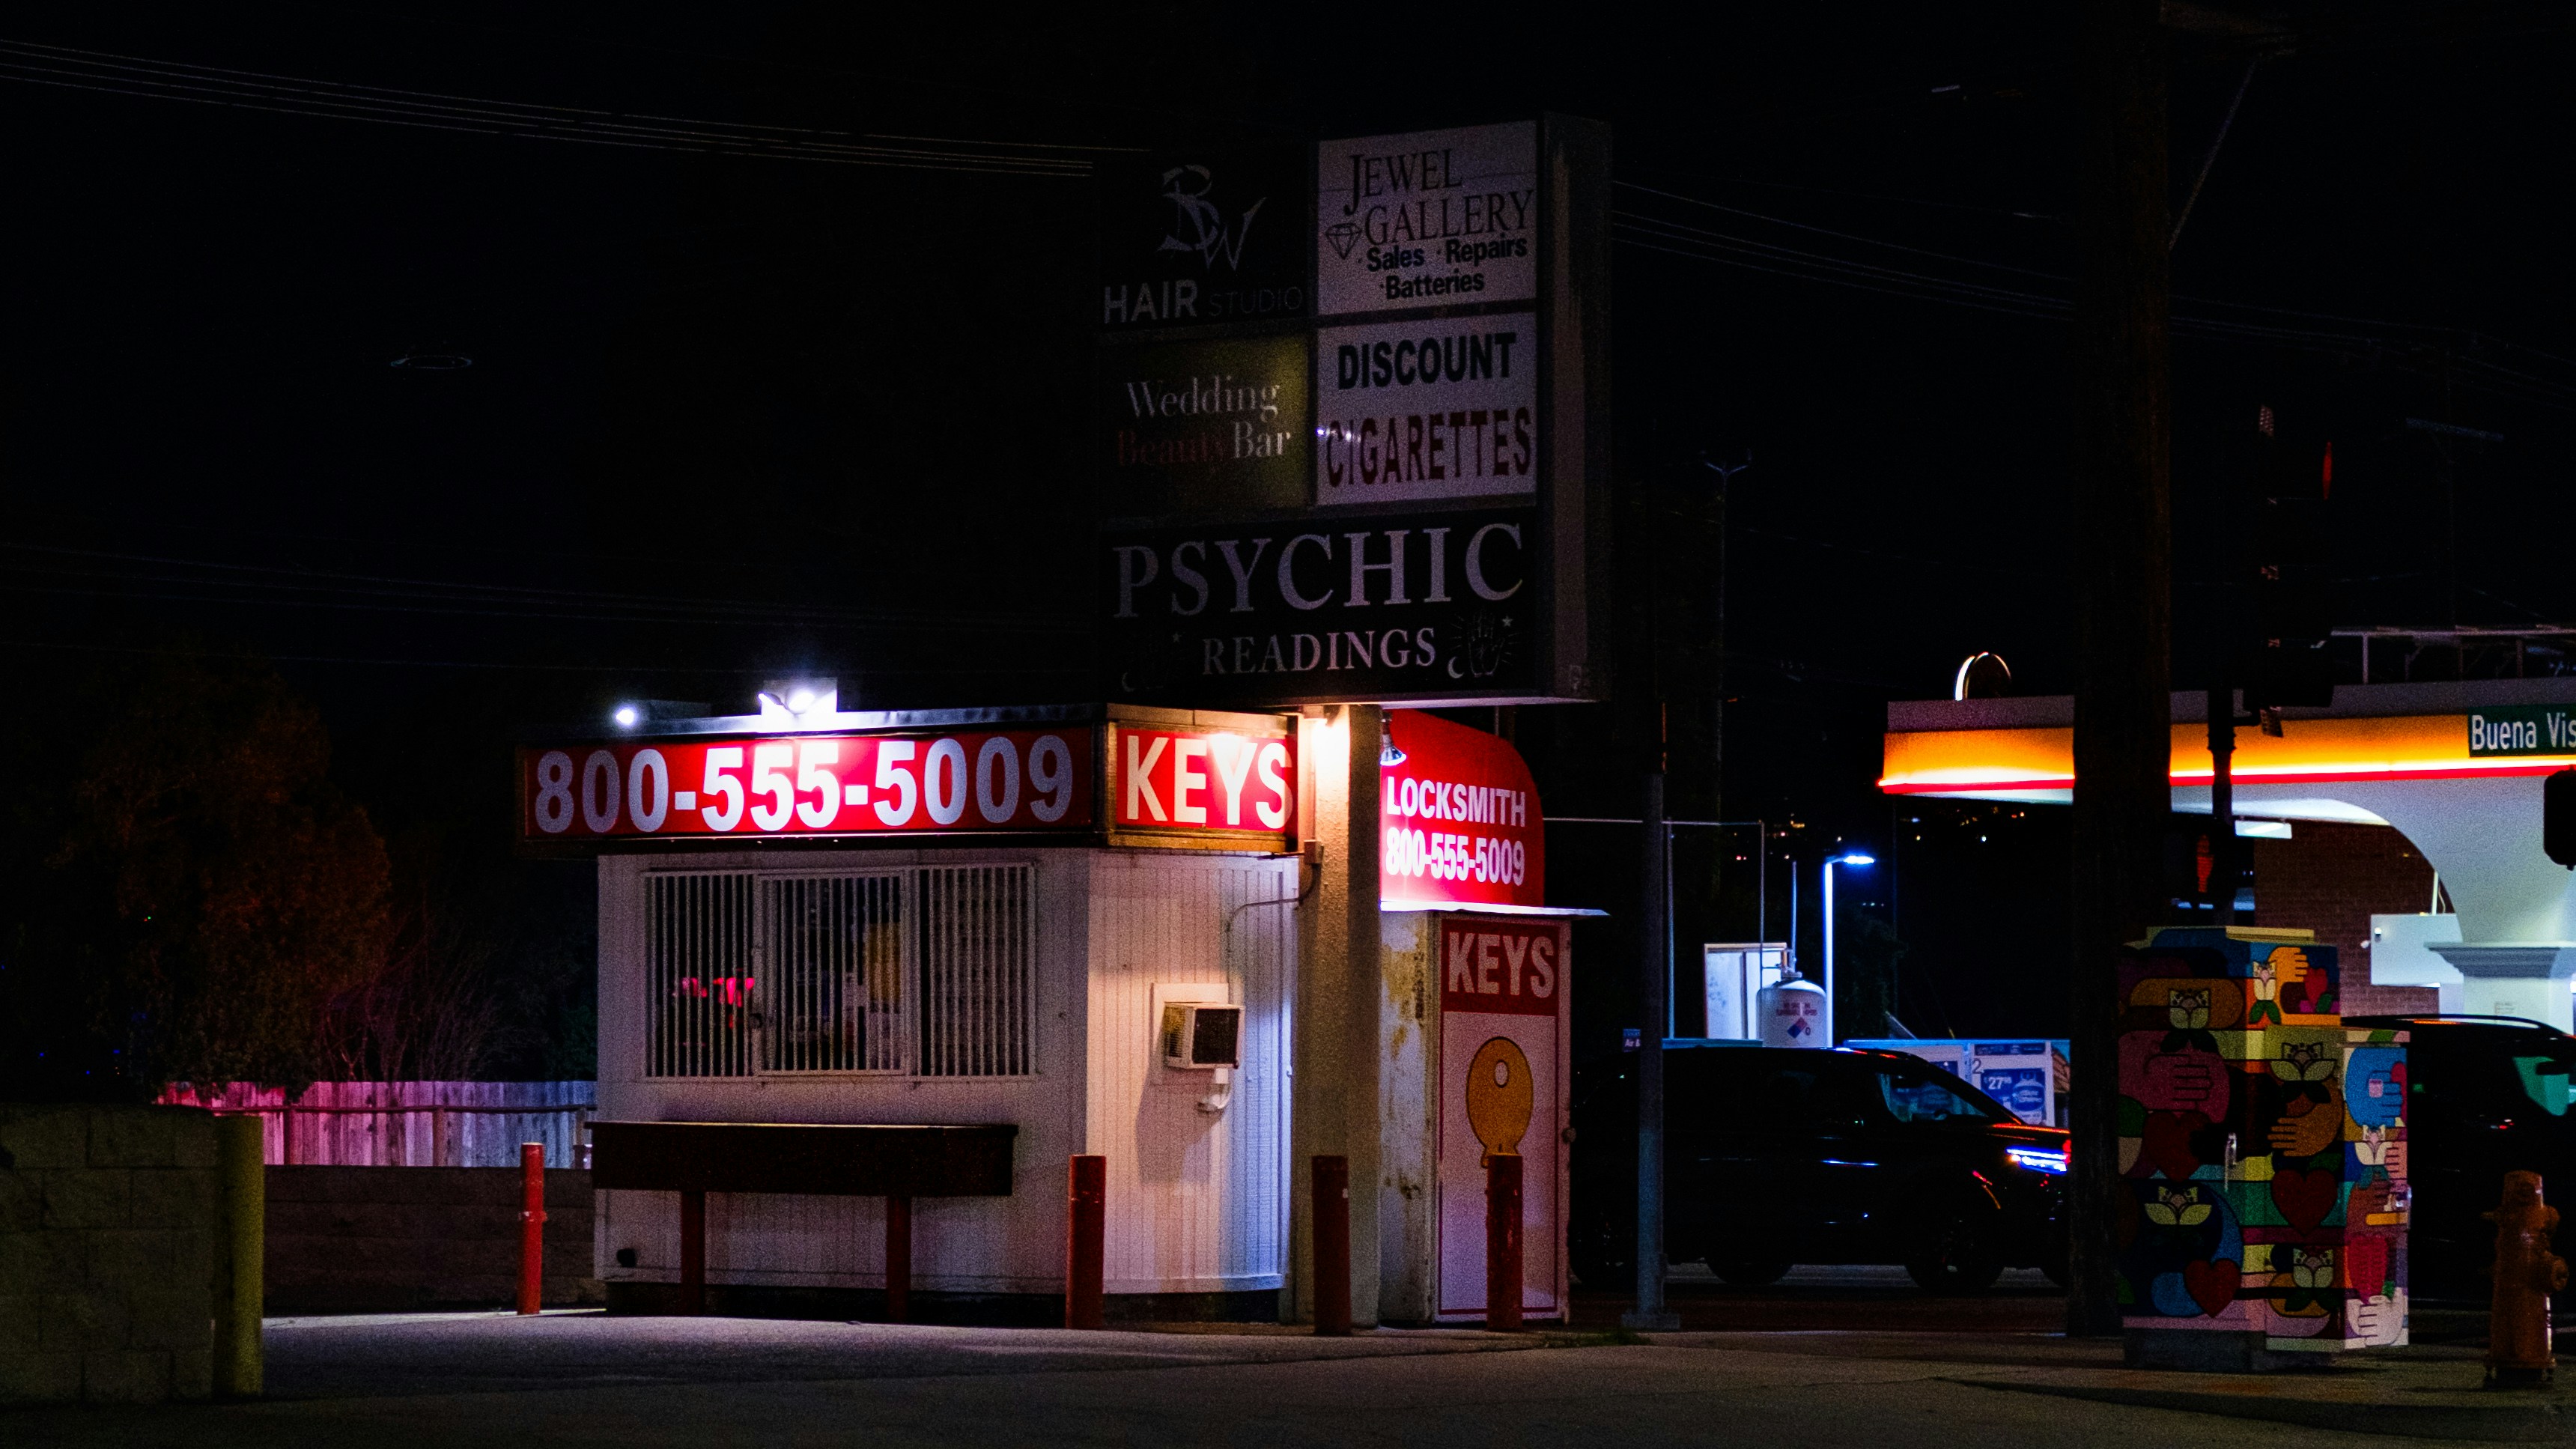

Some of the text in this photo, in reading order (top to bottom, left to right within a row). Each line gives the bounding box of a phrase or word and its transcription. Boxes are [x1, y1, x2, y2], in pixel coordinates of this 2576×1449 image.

[1344, 149, 1462, 216] JEWEL
[1366, 189, 1534, 246] GALLERY
[1367, 233, 1528, 272] Sales Repairs
[1104, 279, 1303, 324] HAIR STUDIO
[1386, 268, 1484, 300] Batteries
[1339, 332, 1516, 390] DISCOUNT
[1125, 375, 1281, 423] Wedding
[1233, 420, 1291, 458] Bar
[1327, 407, 1531, 487] CIGARETTES
[1113, 523, 1523, 619] PSYCHIC
[1202, 627, 1436, 675] READINGS
[2471, 714, 2537, 750] Buena
[535, 735, 1073, 833] 800-555-5009
[1126, 734, 1293, 829] KEYS
[1387, 777, 1526, 827] LOCKSMITH
[1385, 826, 1525, 887] 800-555-5009
[1448, 931, 1555, 998] KEYS
[1972, 1058, 1981, 1074] 2
